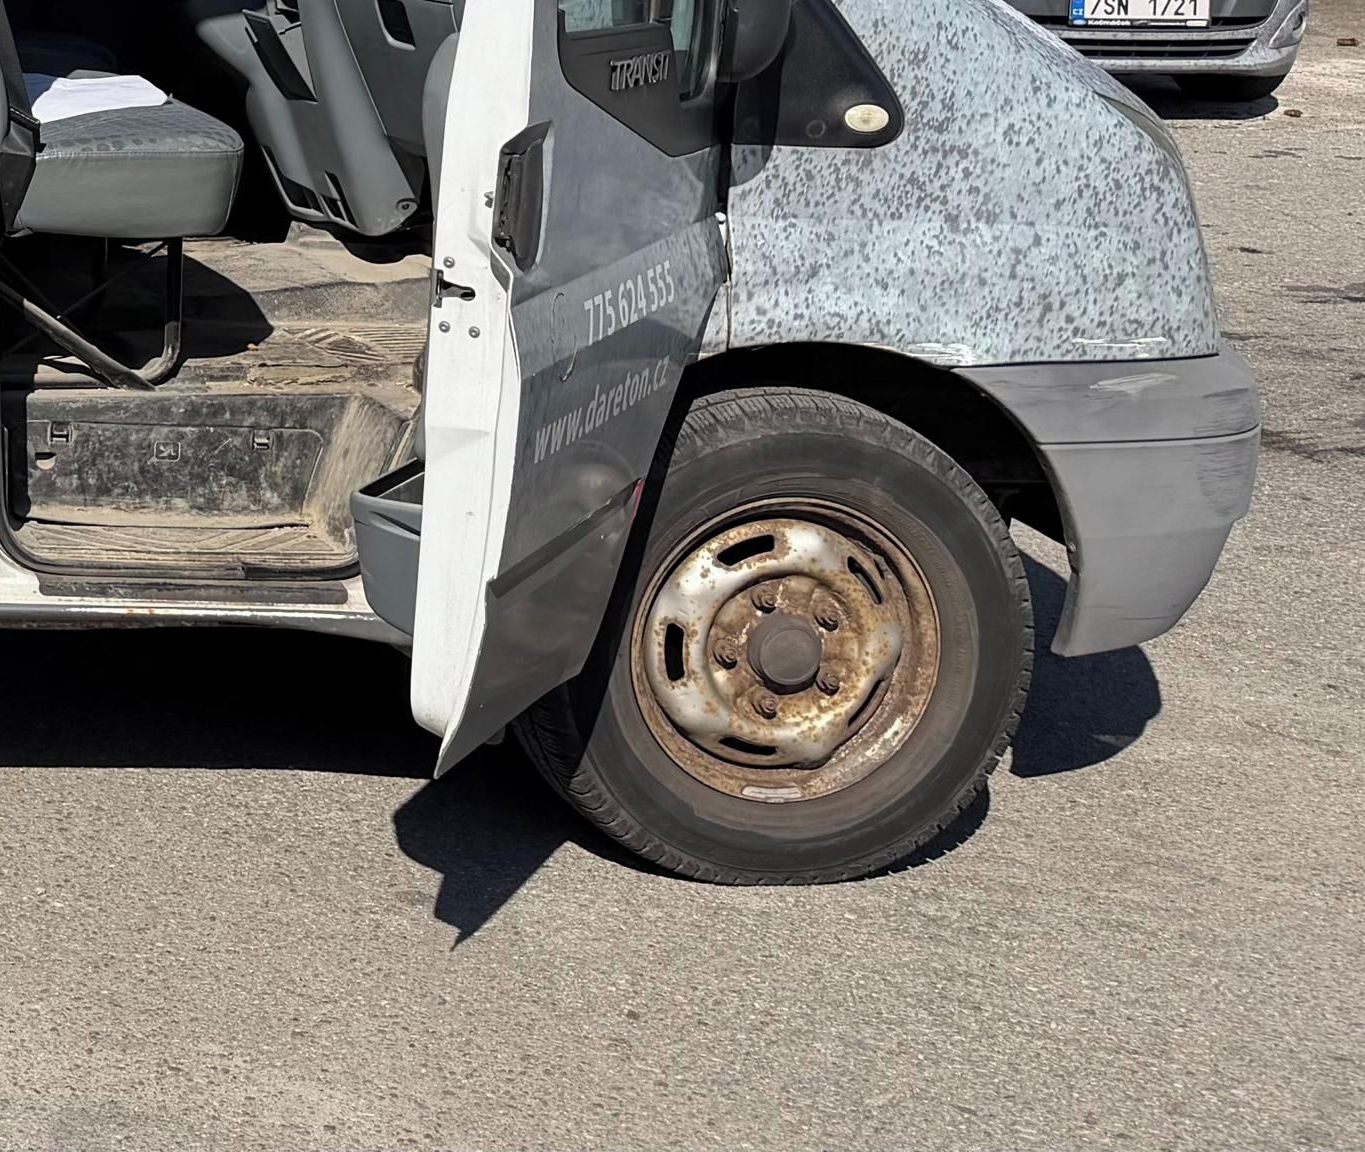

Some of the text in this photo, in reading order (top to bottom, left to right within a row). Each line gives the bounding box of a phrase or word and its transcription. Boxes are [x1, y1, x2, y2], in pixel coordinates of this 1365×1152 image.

[609, 50, 670, 91] TRANSIT
[583, 259, 675, 346] 775 624 555
[534, 355, 670, 464] www.dareton.cz
